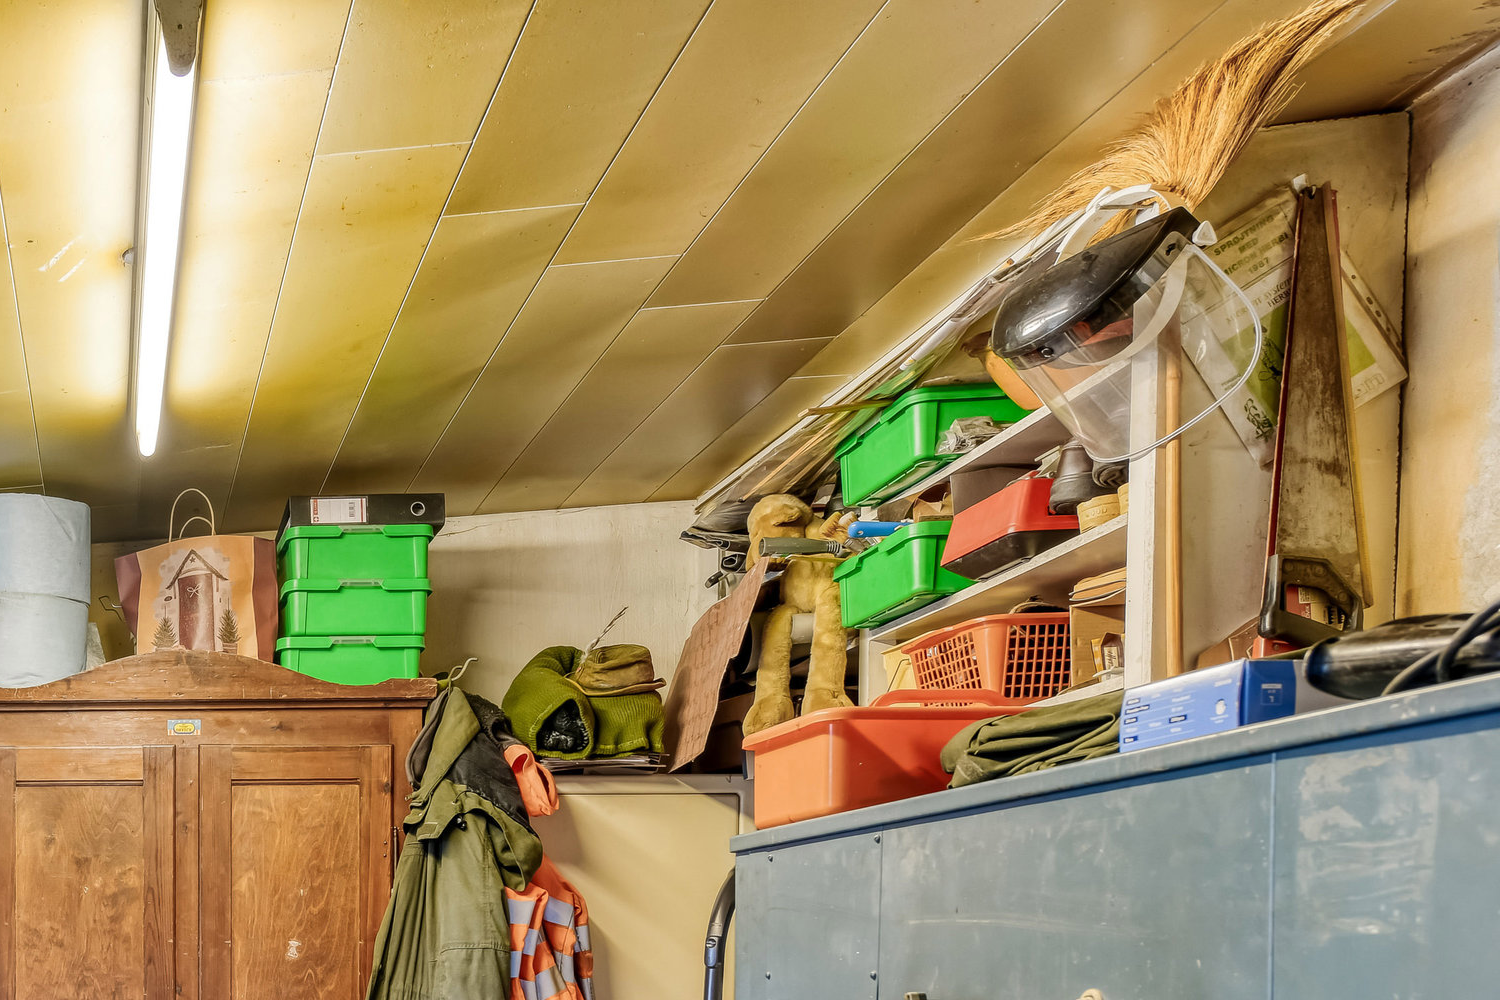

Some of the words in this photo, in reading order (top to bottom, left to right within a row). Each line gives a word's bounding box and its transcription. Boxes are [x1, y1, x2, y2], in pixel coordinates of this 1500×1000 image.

[1238, 237, 1258, 254] MED
[1248, 257, 1270, 274] 1987
[1268, 288, 1291, 307] HERB
